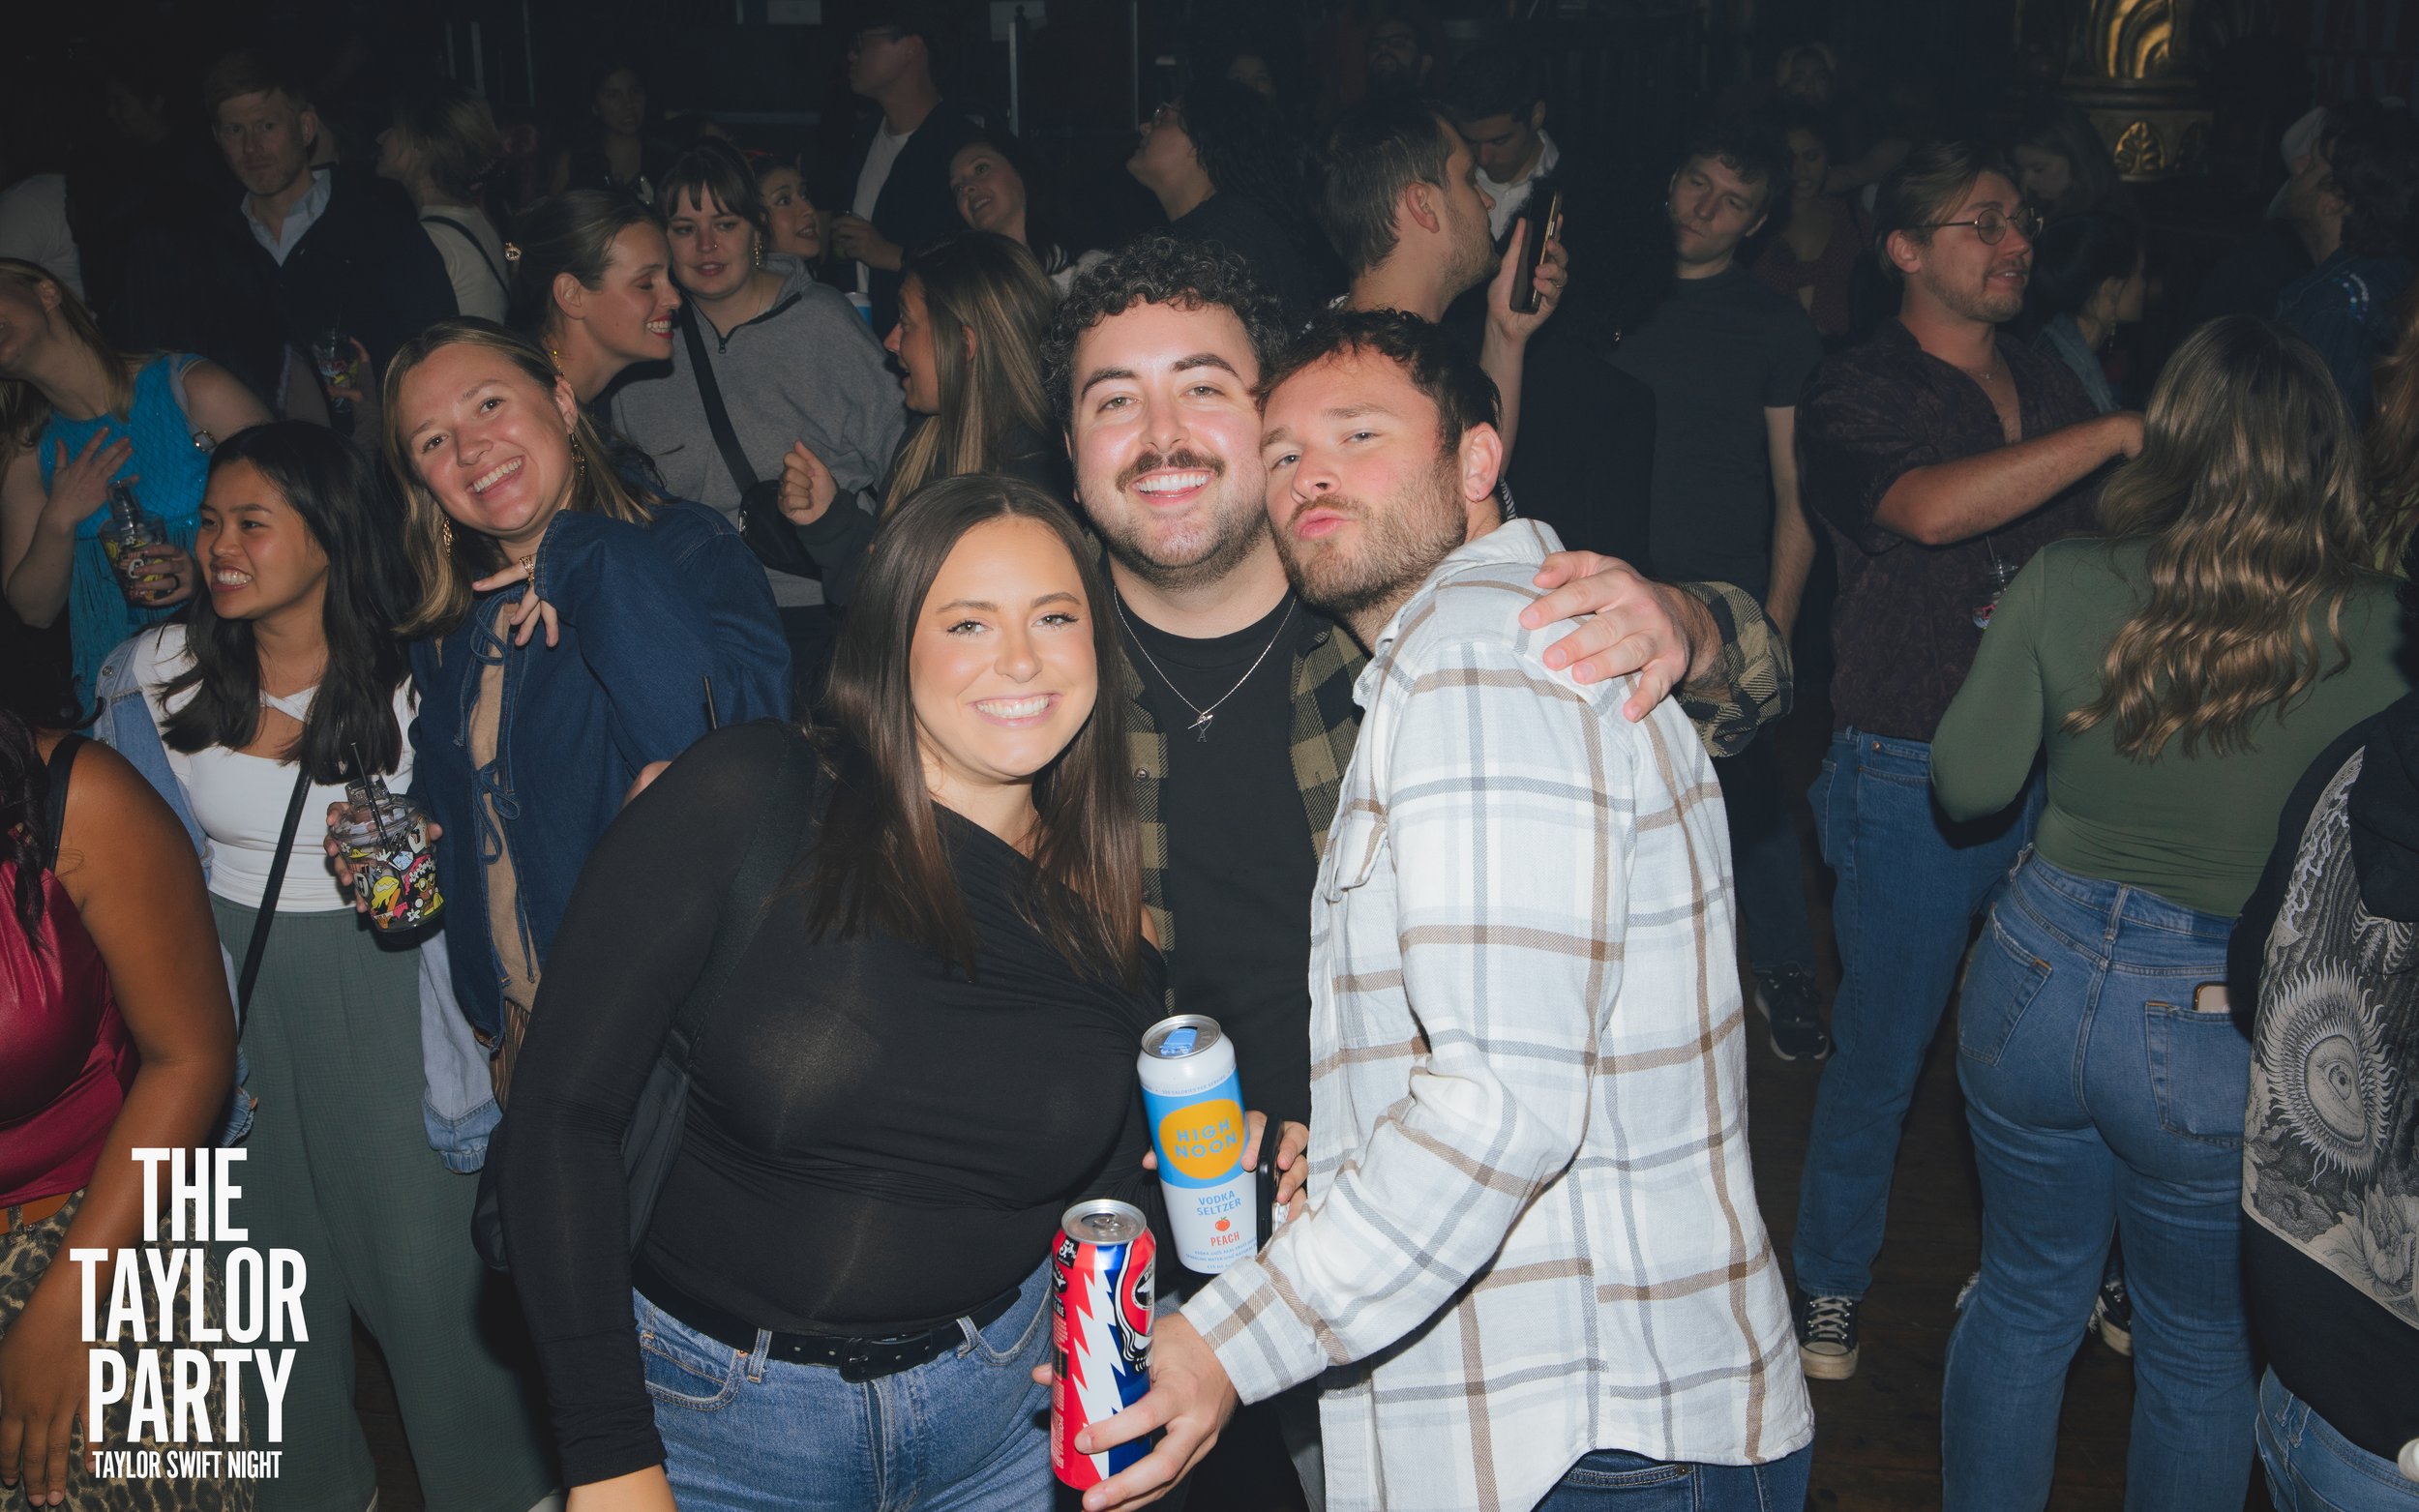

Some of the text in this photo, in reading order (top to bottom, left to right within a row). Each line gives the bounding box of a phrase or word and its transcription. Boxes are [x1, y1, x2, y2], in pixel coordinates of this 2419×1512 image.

[1176, 1117, 1231, 1142] HIGH
[1175, 1131, 1238, 1158] NOON
[1198, 1190, 1236, 1205] VODKA
[1196, 1198, 1241, 1216] SELTZER
[1210, 1231, 1239, 1246] PEACH
